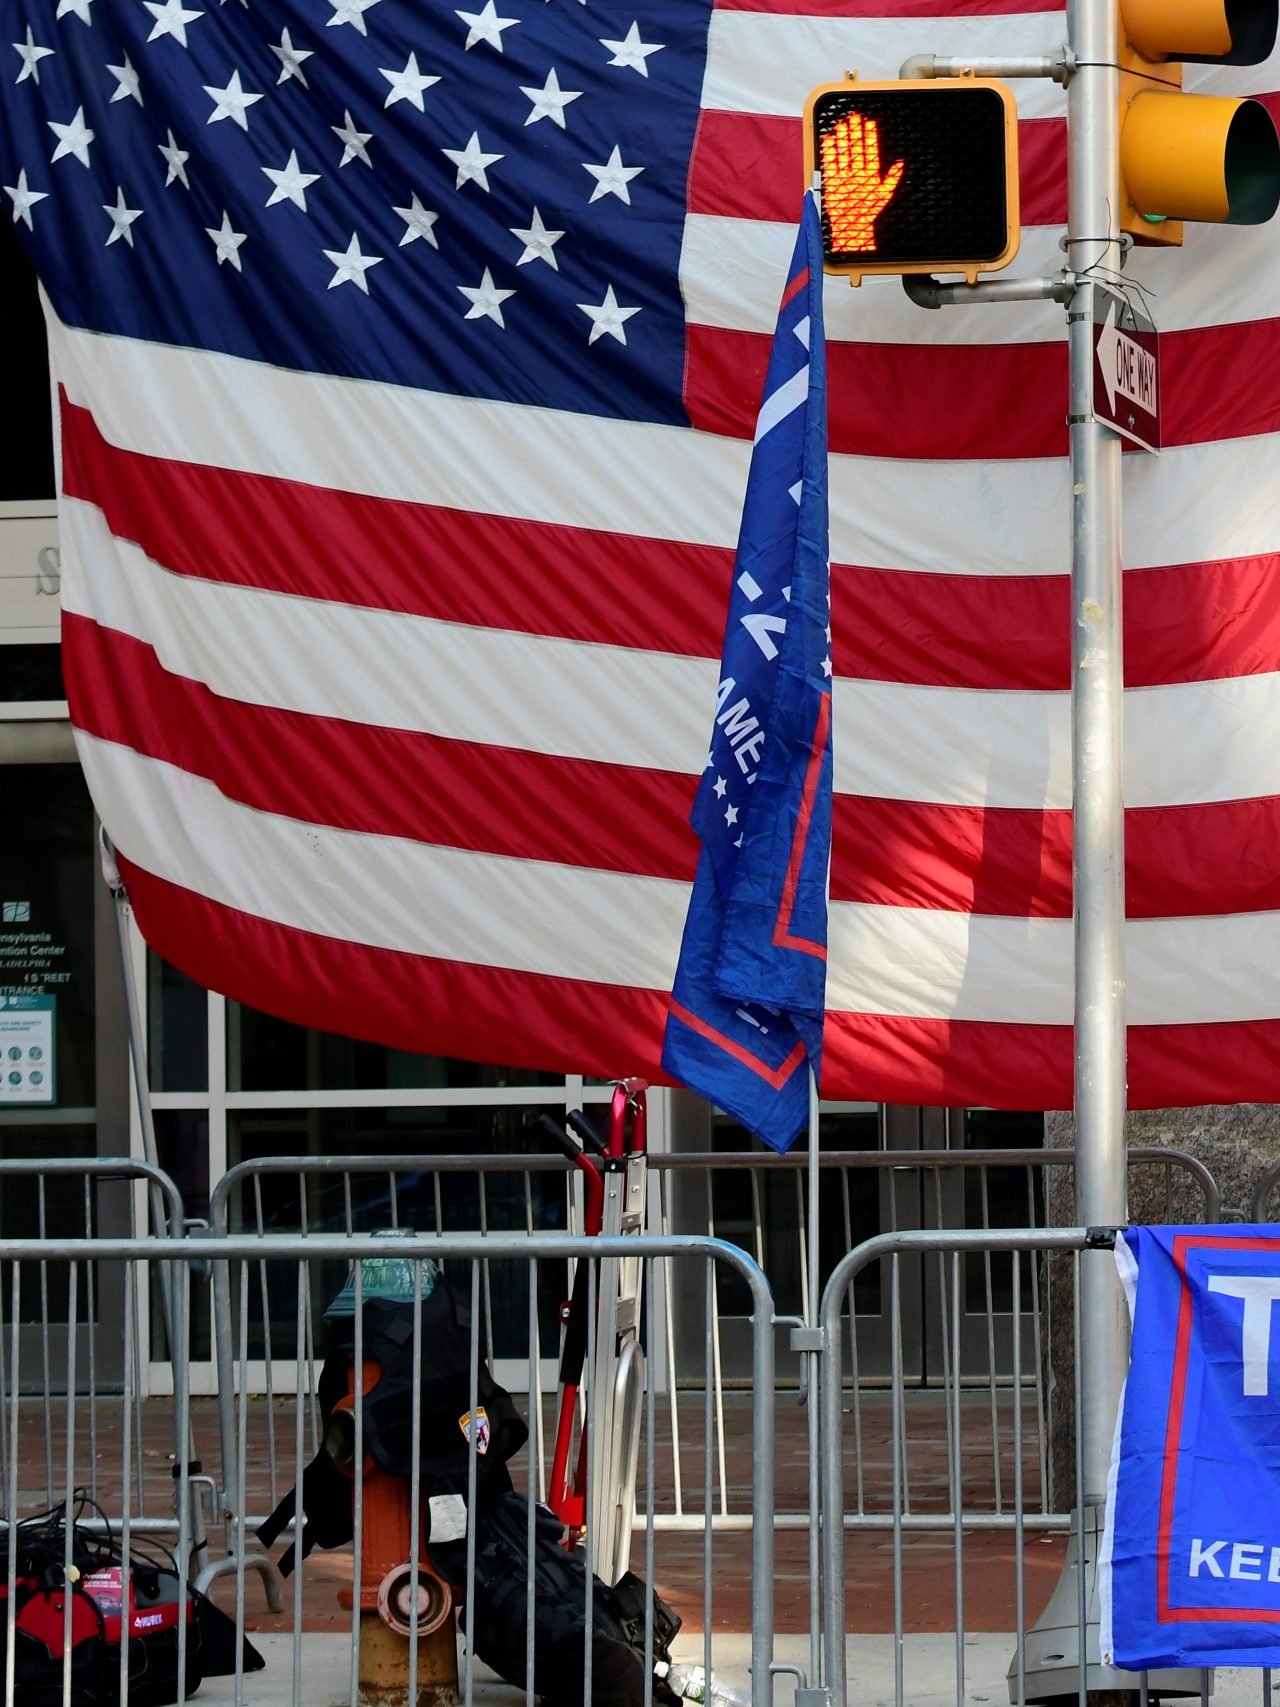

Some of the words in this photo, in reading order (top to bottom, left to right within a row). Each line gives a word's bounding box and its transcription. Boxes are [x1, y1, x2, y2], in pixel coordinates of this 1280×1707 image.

[1116, 338, 1135, 395] ONE
[1137, 351, 1154, 408] WAY
[30, 944, 65, 956] Center
[30, 972, 71, 983] SREET
